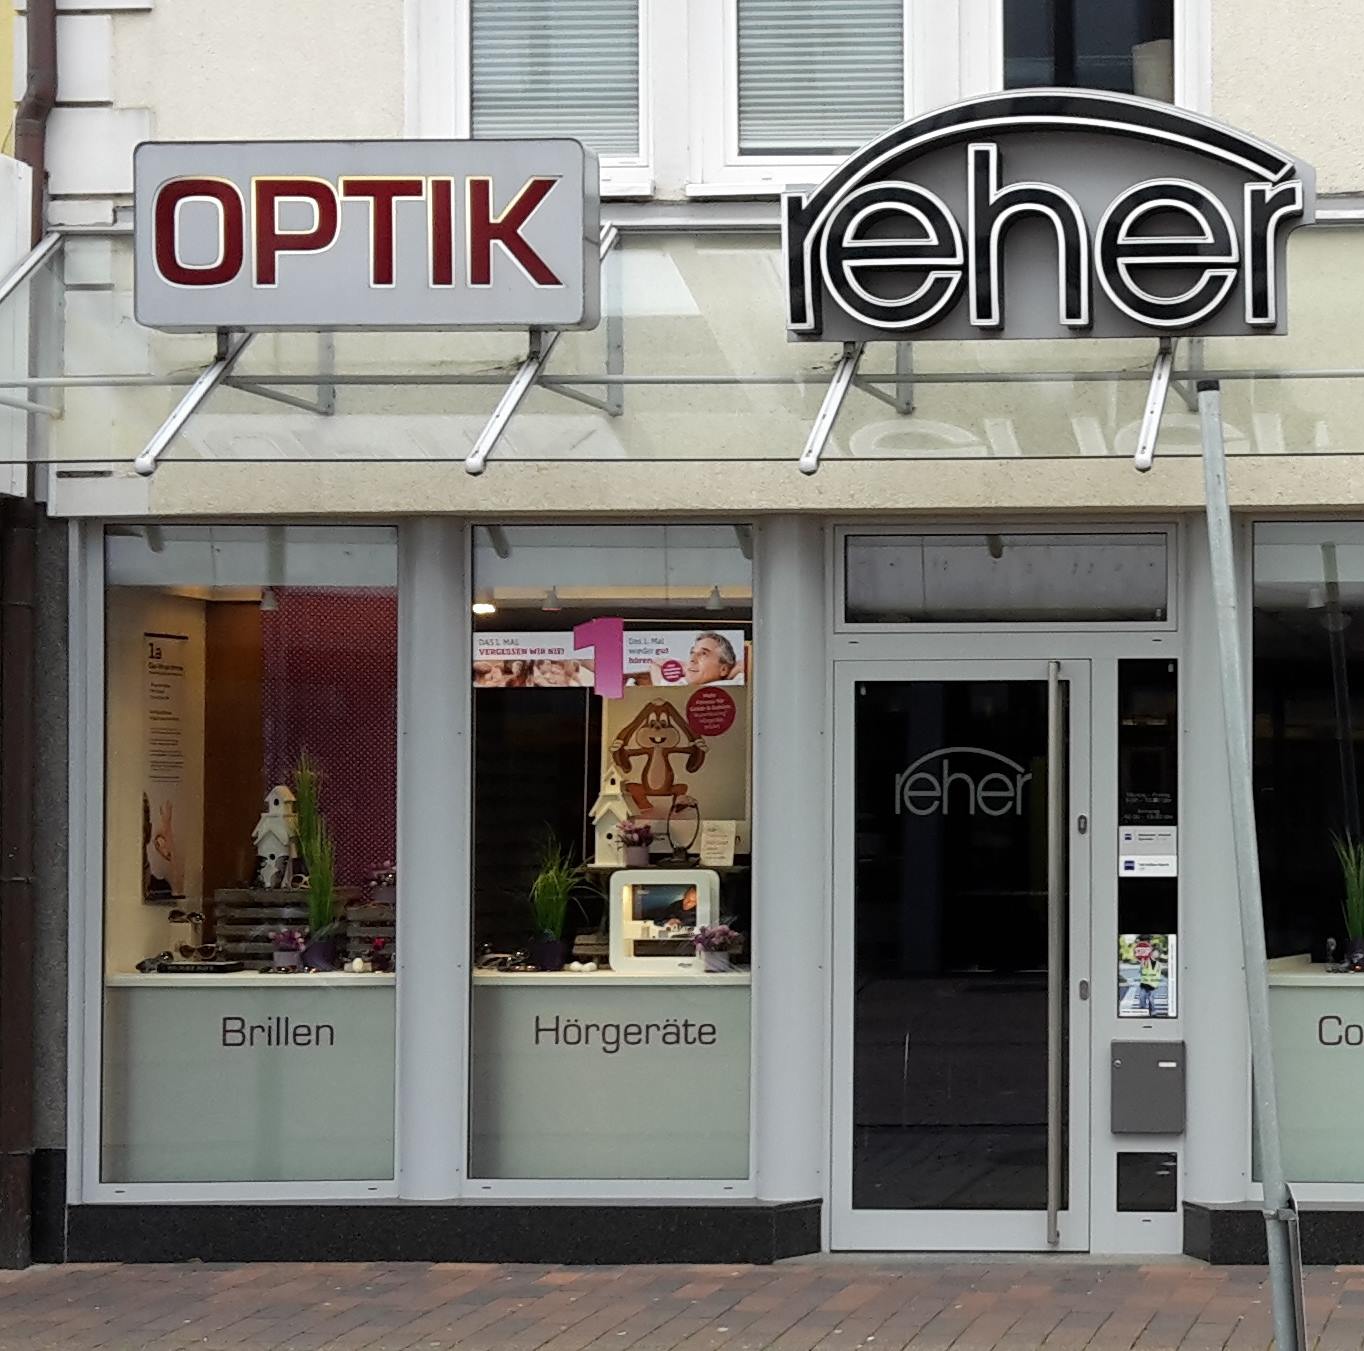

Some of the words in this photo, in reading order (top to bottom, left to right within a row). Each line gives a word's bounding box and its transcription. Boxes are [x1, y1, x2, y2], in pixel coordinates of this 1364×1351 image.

[153, 174, 565, 289] OPTIK
[781, 88, 1305, 332] reher
[895, 747, 1032, 816] reher
[222, 1016, 335, 1047] Brillen
[533, 1015, 717, 1054] Hörgeräte
